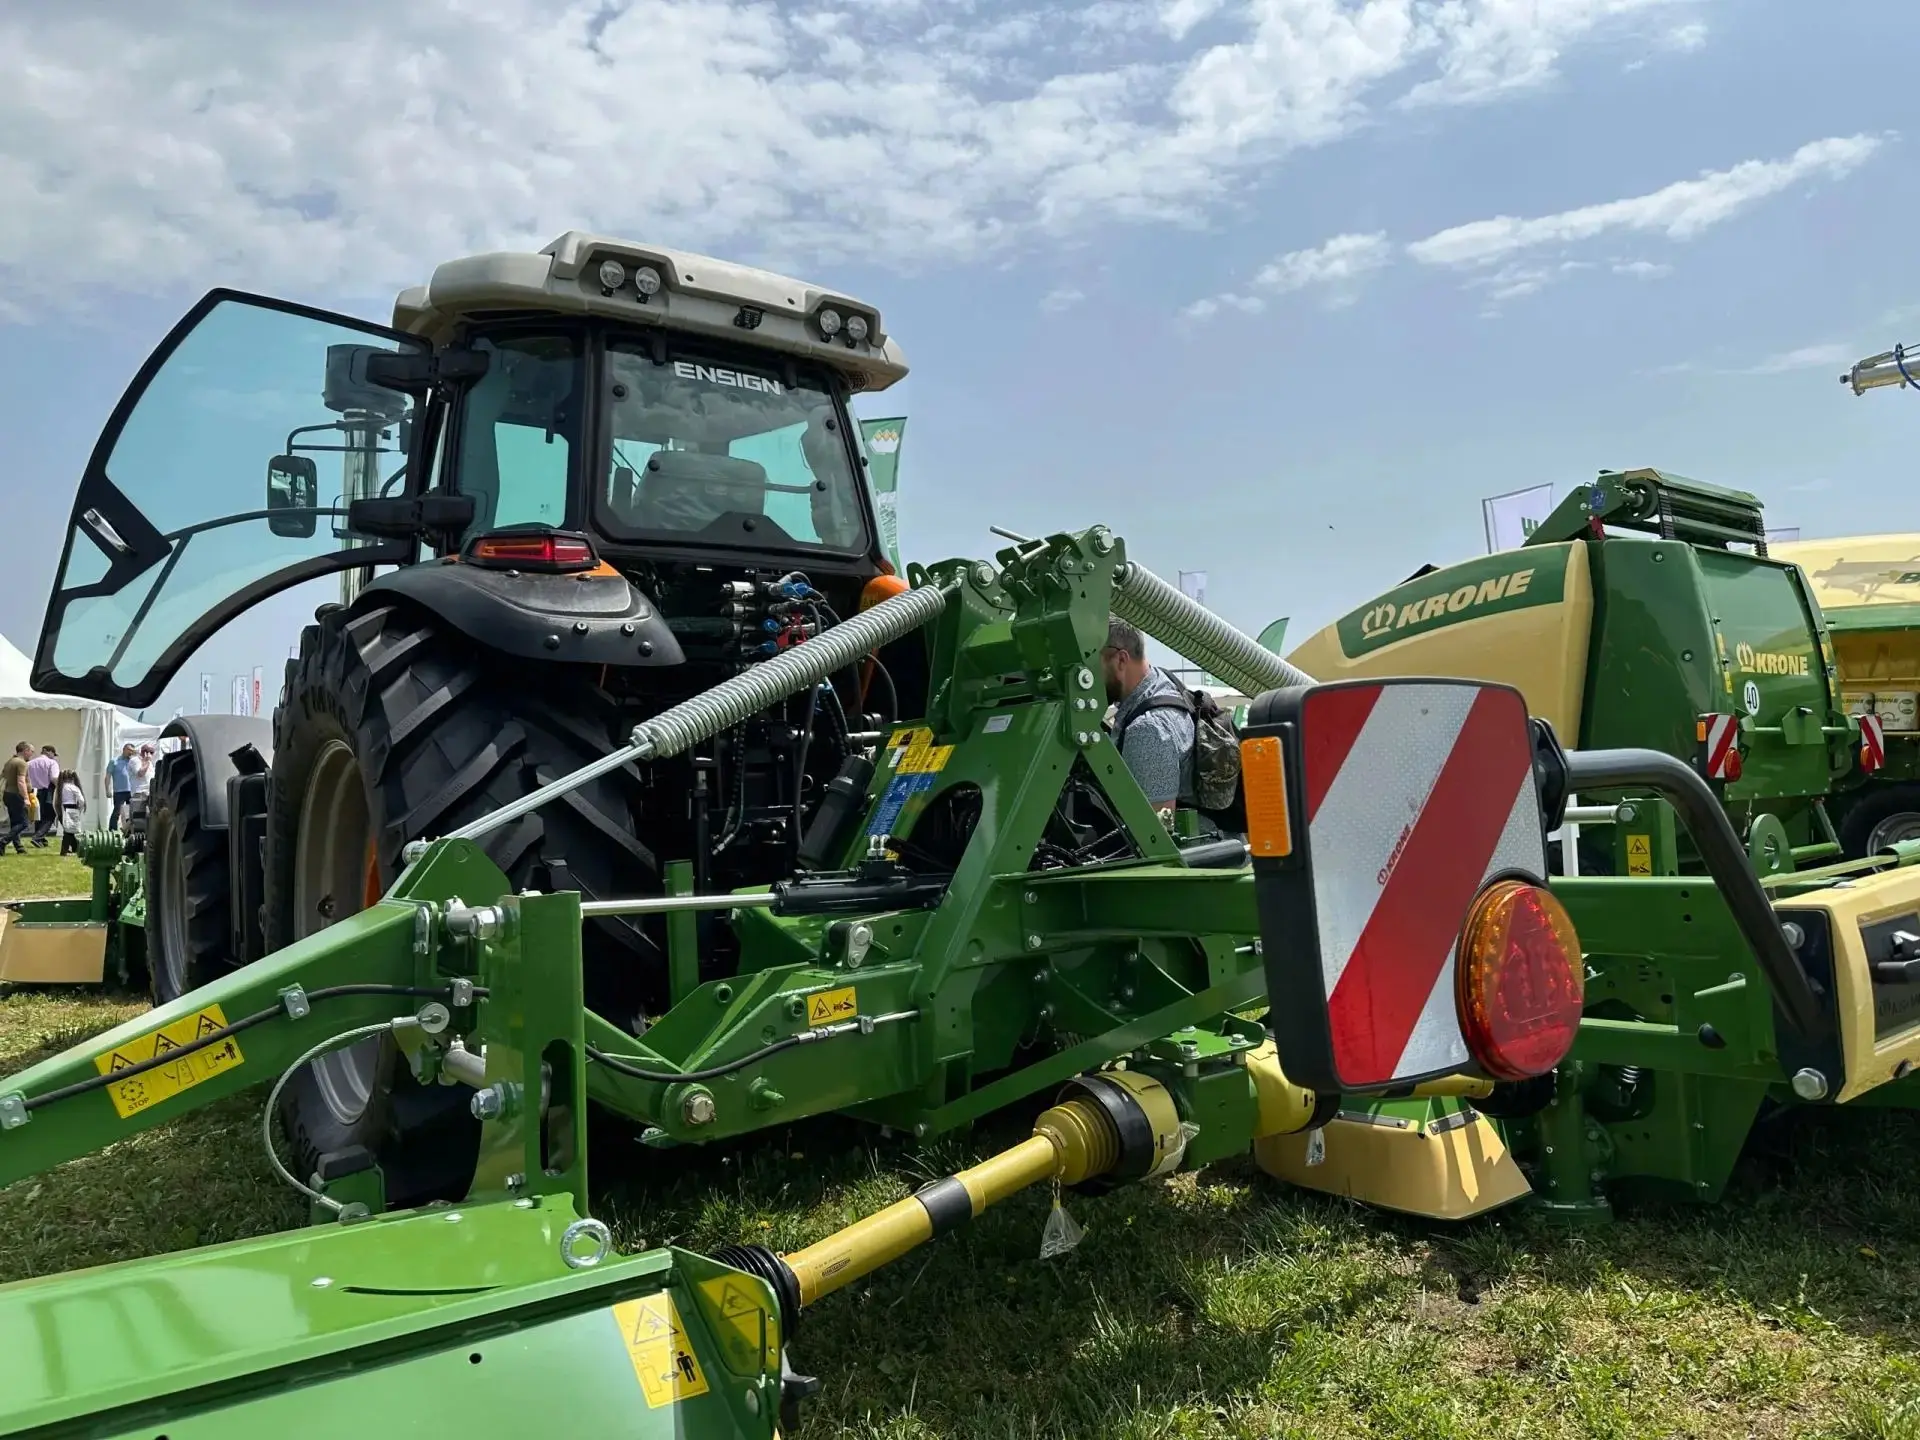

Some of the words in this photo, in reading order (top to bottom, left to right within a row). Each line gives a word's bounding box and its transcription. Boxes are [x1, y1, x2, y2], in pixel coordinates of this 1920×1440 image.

[674, 361, 781, 395] ENSIGN
[1396, 568, 1536, 629] KRONE
[1755, 653, 1808, 676] KRONE
[1746, 686, 1758, 710] 40
[1385, 823, 1412, 875] KRONE
[128, 1097, 149, 1111] STOP
